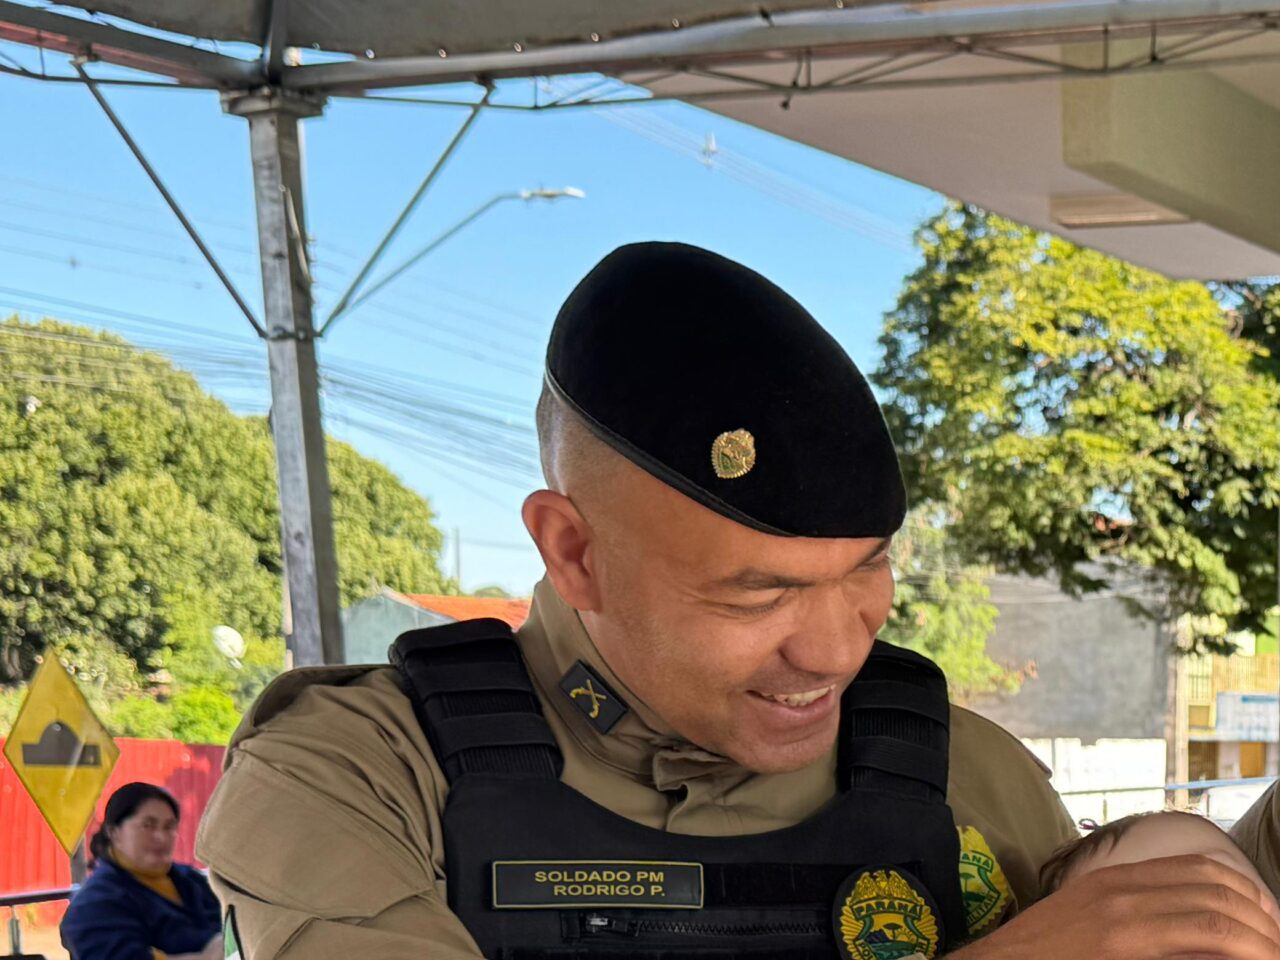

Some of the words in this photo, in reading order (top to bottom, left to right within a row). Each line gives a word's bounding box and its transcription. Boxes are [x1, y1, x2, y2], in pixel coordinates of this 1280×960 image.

[534, 871, 631, 882] SOLDADO
[636, 871, 664, 882] PM
[553, 885, 645, 896] RODRIGO
[650, 885, 666, 897] P.
